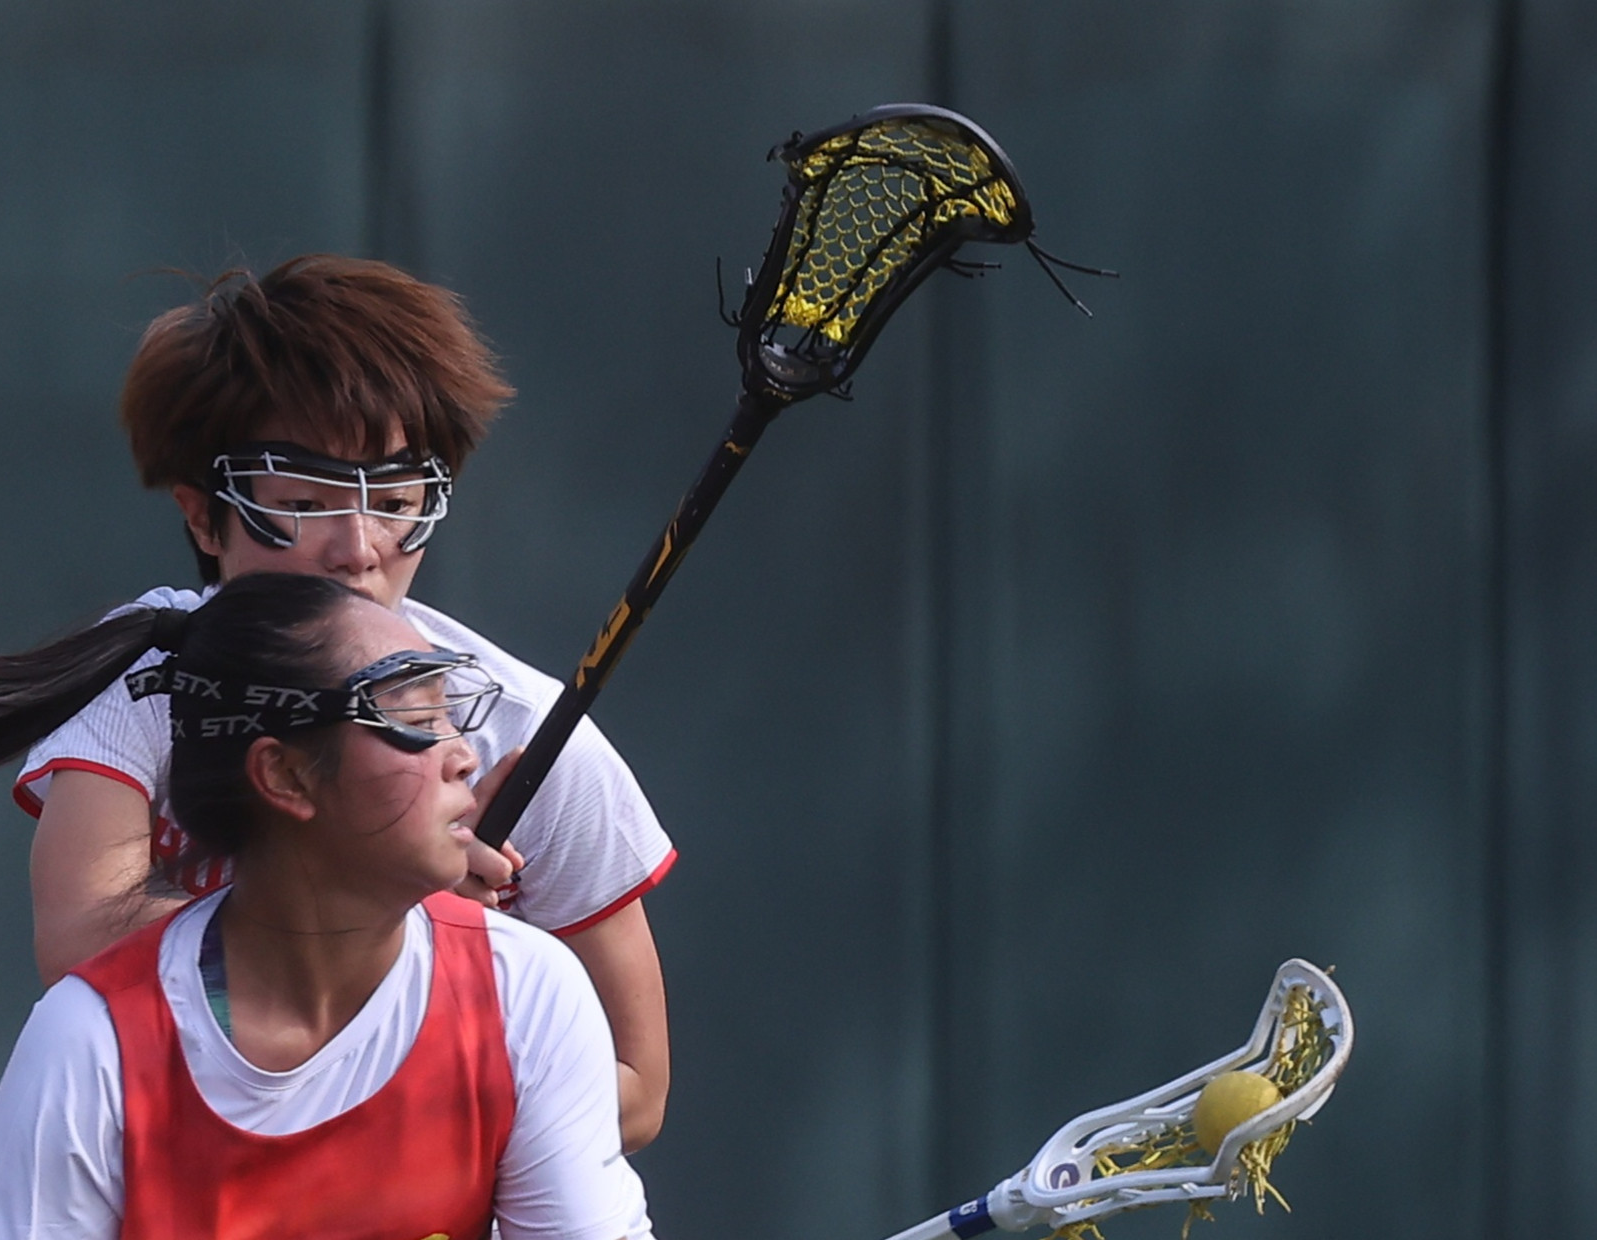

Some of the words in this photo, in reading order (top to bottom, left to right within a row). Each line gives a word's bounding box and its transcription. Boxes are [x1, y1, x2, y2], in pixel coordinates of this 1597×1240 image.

[172, 670, 222, 700] STX
[244, 684, 322, 711] STX
[201, 712, 265, 737] STX
